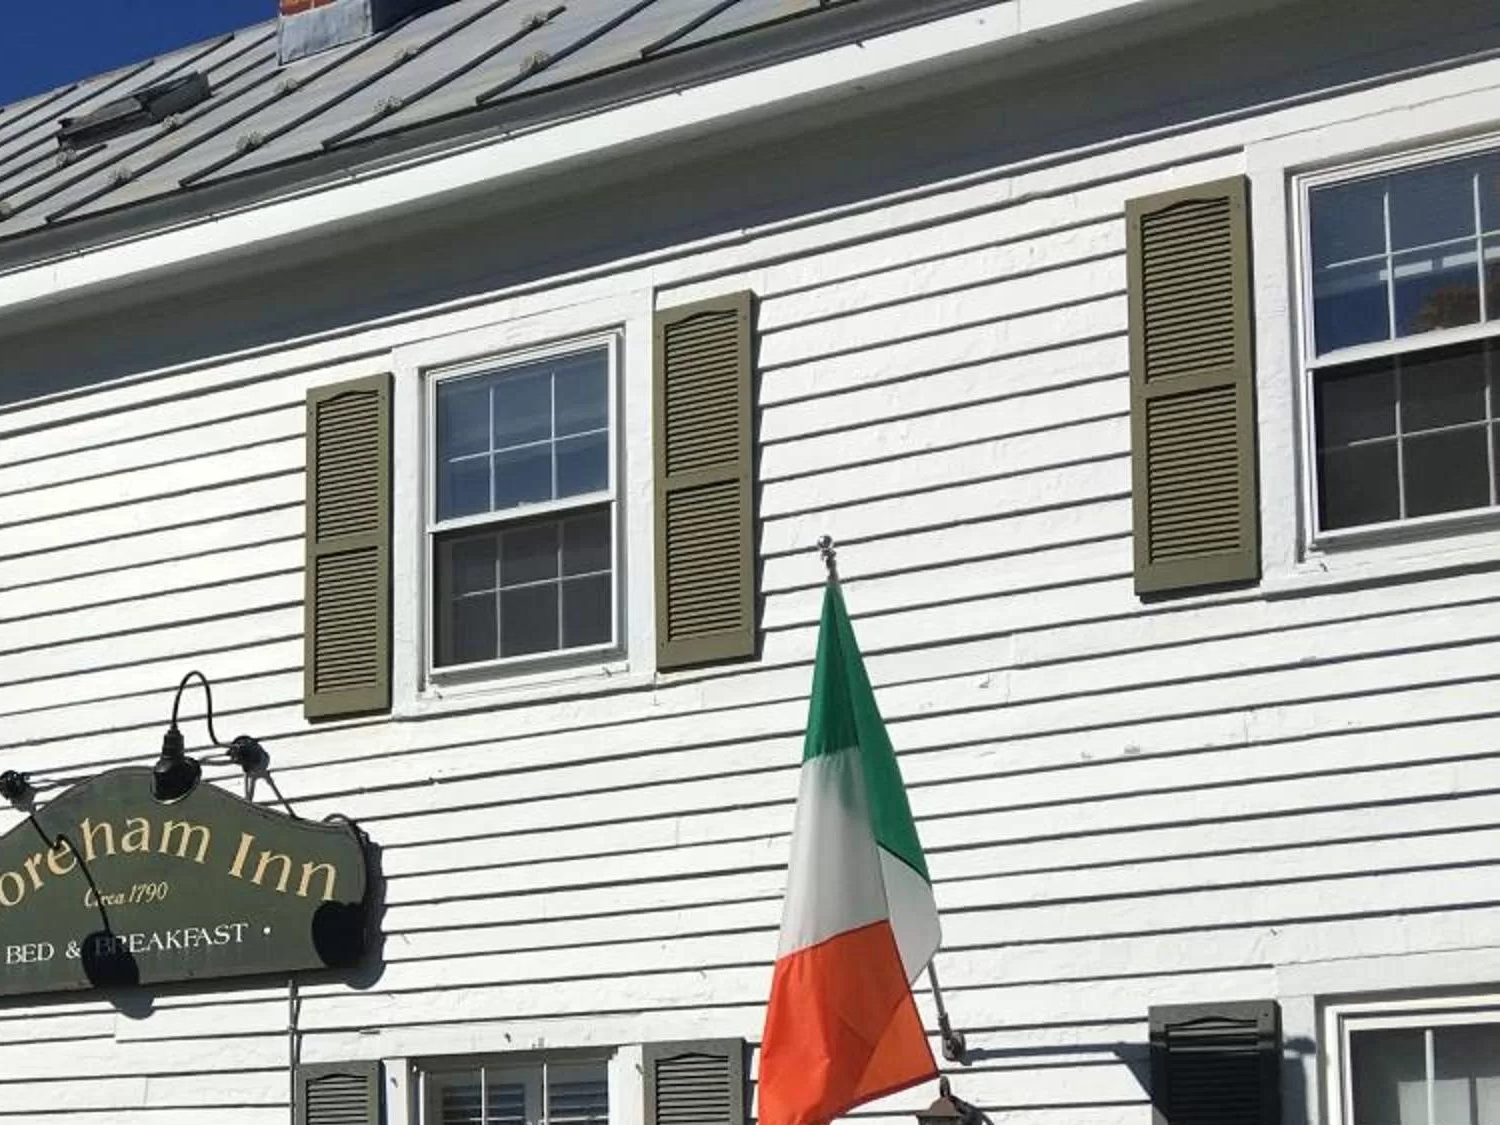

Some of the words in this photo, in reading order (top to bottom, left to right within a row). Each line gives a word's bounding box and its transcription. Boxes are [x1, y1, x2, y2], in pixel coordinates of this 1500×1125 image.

[228, 831, 337, 901] Inn
[129, 881, 169, 903] 1790
[6, 942, 54, 964] BED
[65, 940, 81, 959] &
